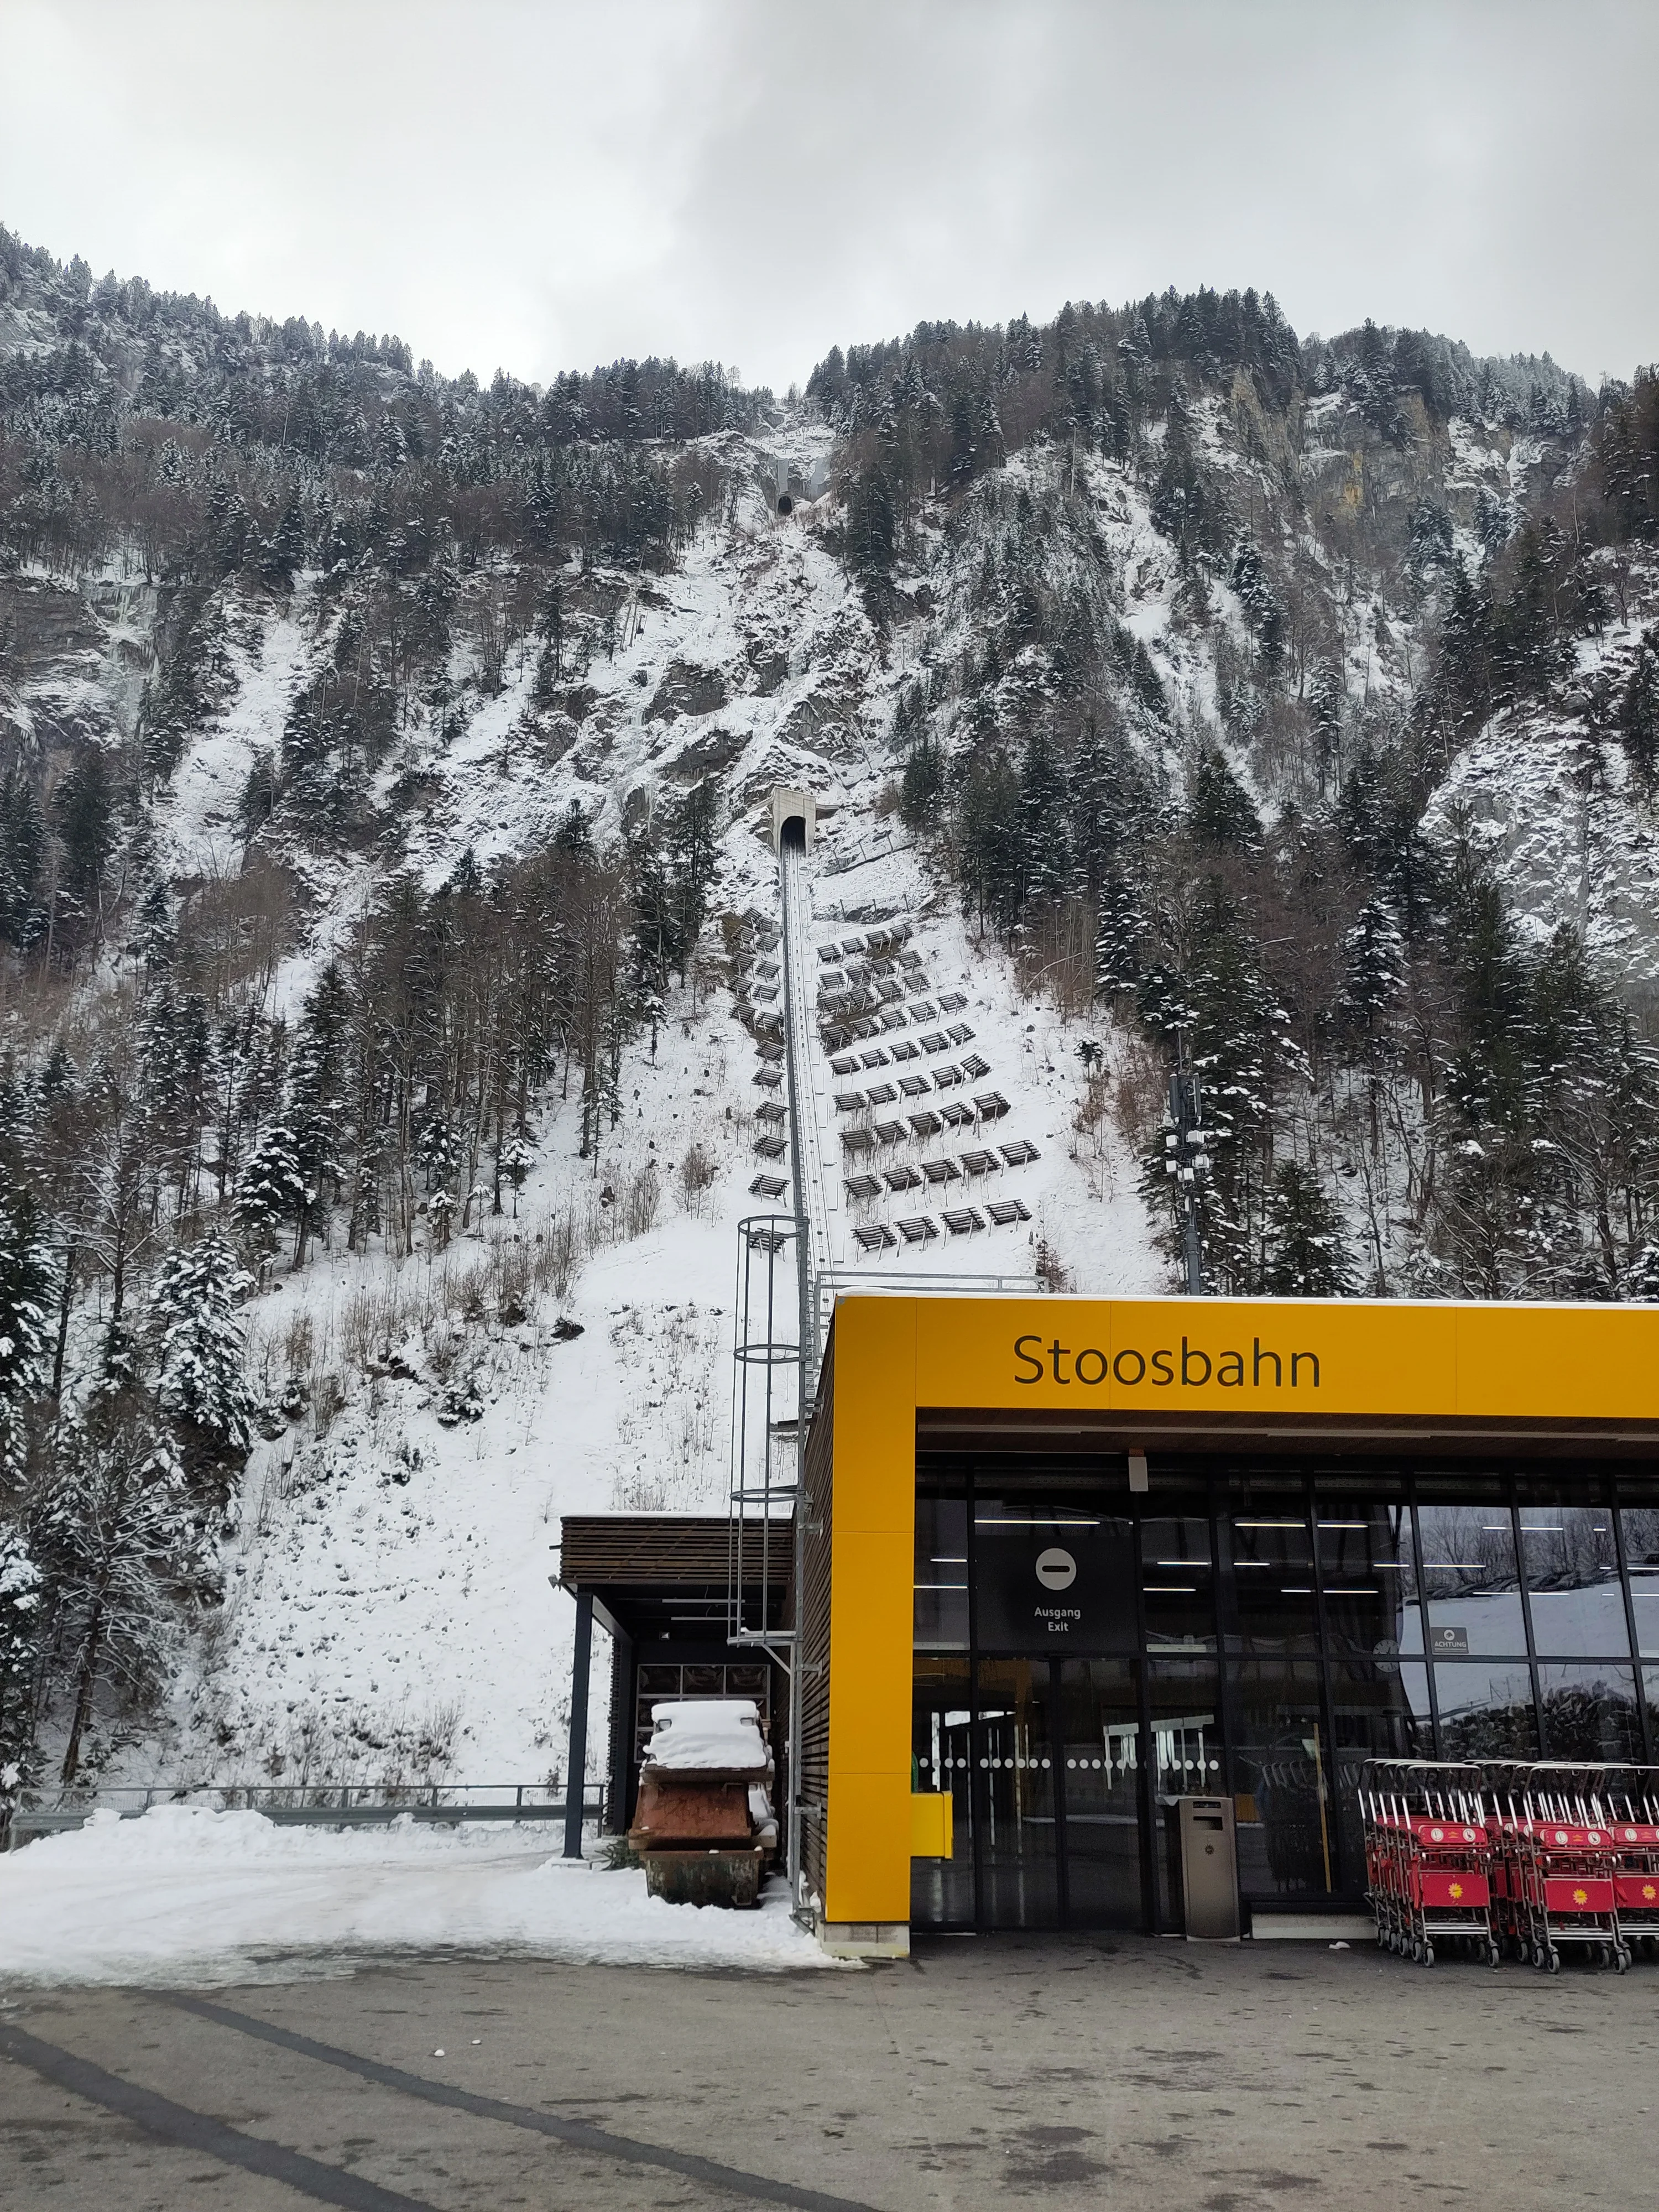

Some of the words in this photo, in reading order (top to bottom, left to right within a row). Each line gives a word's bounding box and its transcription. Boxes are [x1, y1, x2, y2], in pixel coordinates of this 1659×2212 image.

[1014, 1335, 1320, 1387] Stoosbahn
[1034, 1606, 1081, 1620] Ausgang
[1048, 1621, 1069, 1632] Exit
